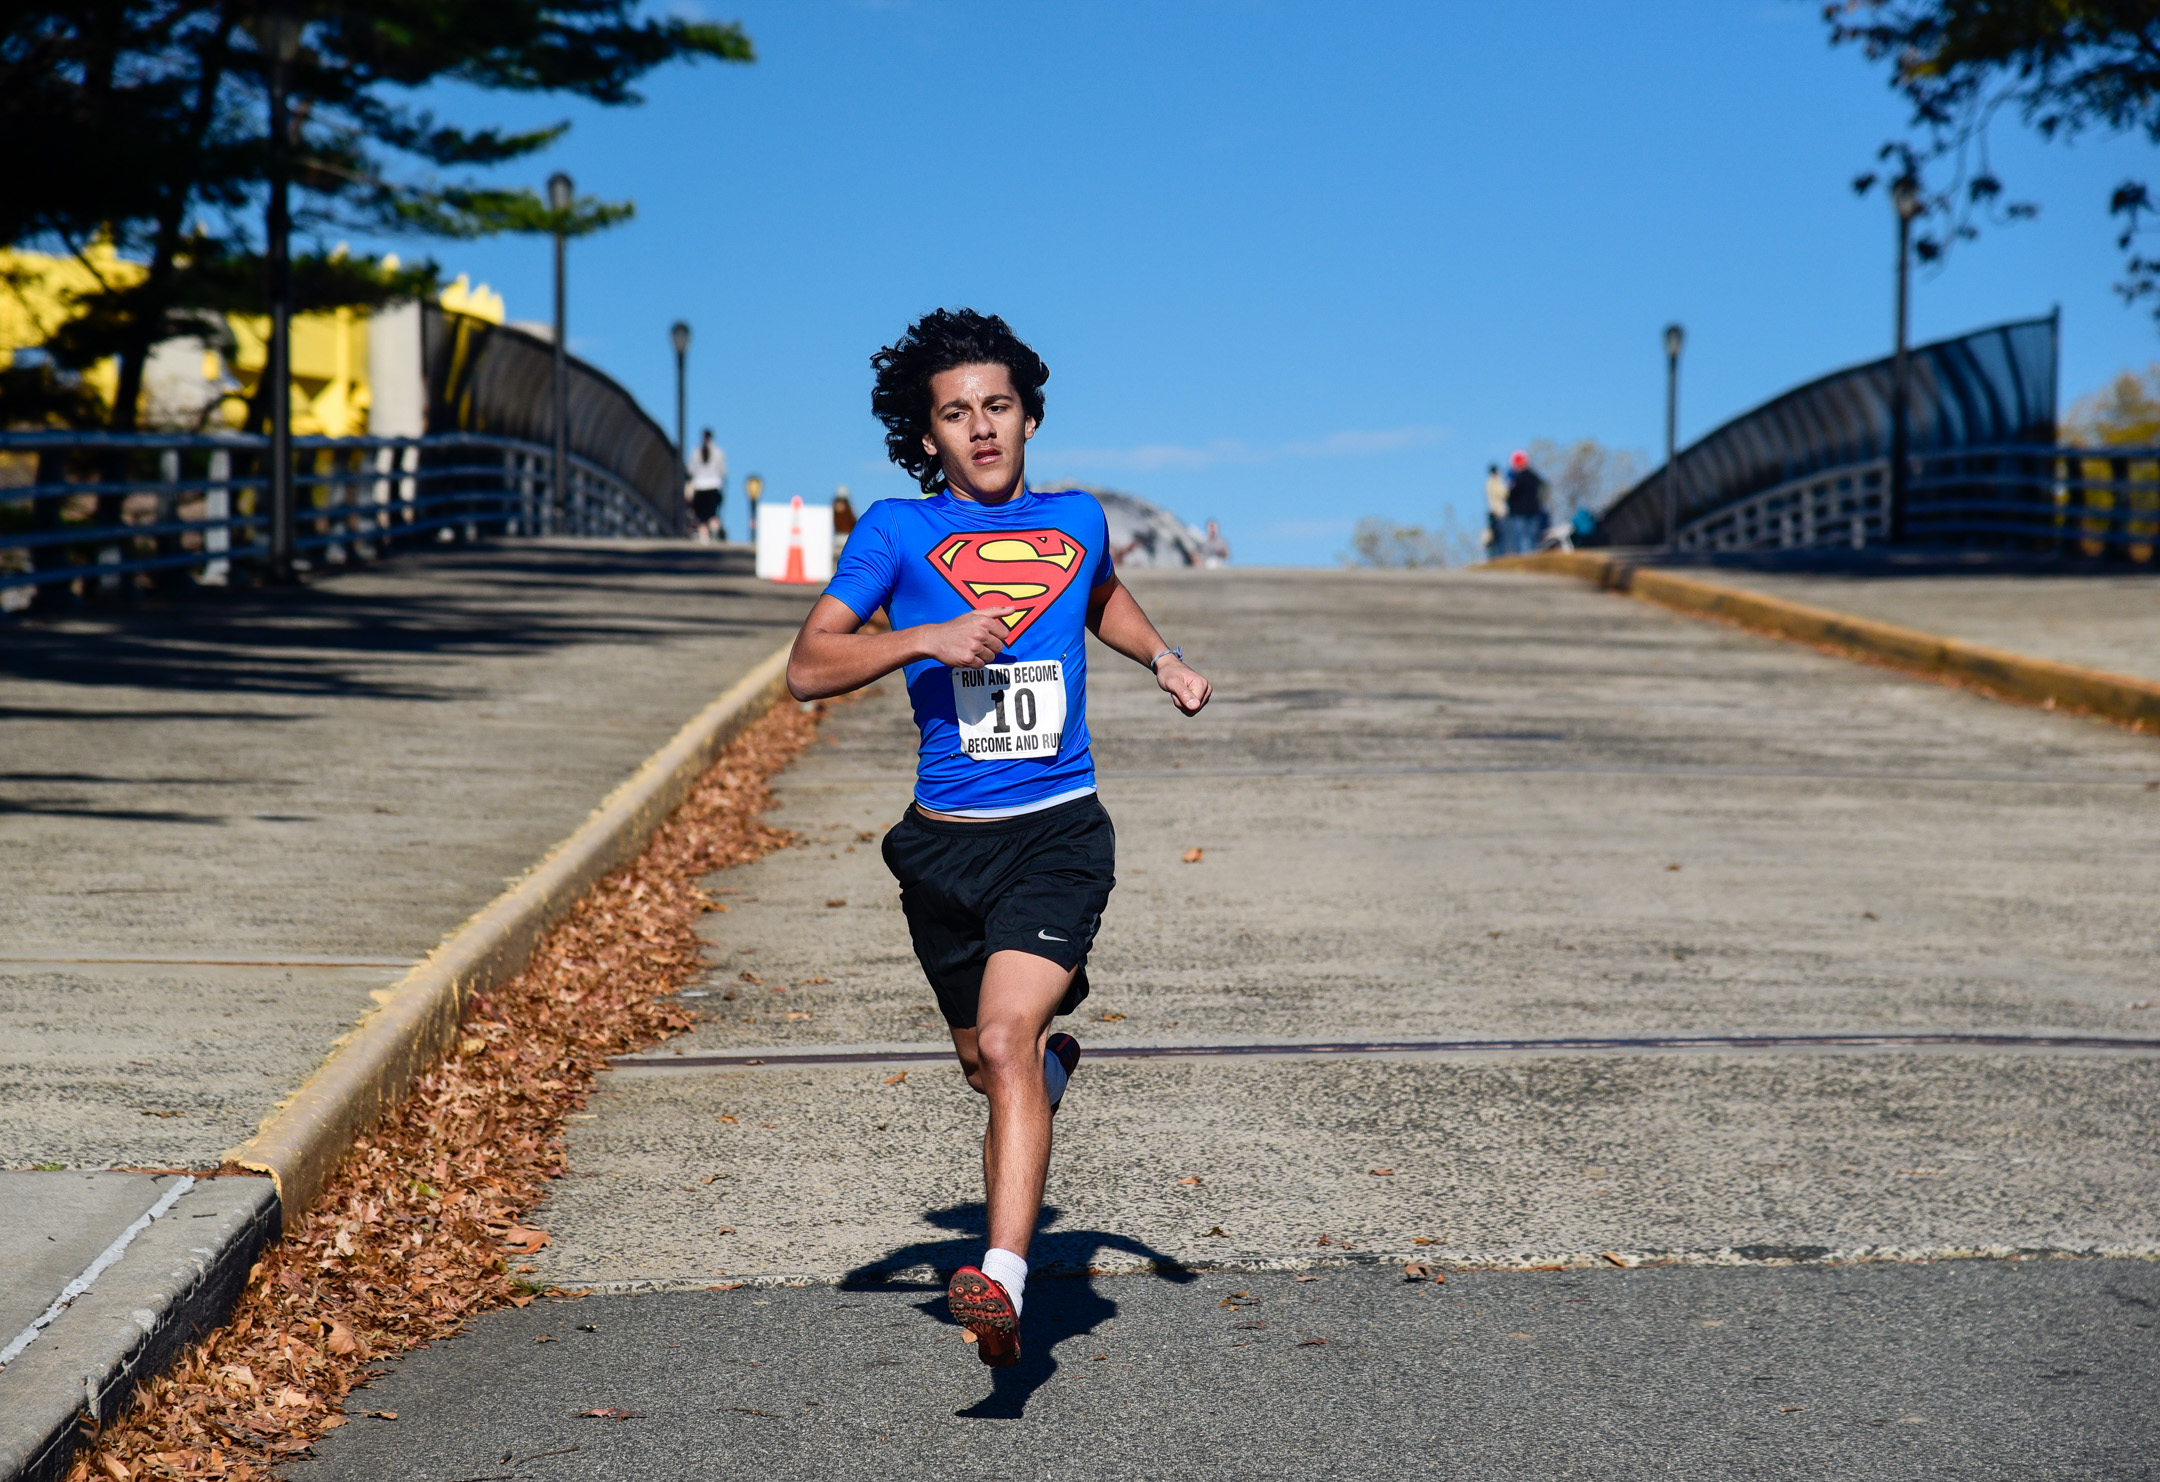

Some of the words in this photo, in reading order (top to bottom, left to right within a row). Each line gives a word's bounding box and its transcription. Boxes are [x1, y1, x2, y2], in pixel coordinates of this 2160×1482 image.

[942, 532, 1078, 620] S
[962, 670, 985, 687] RUN
[988, 668, 1010, 686] AND
[1014, 665, 1058, 683] BECOME
[991, 688, 1037, 733] 10
[968, 736, 1012, 753] BECOME
[1016, 734, 1038, 751] AND
